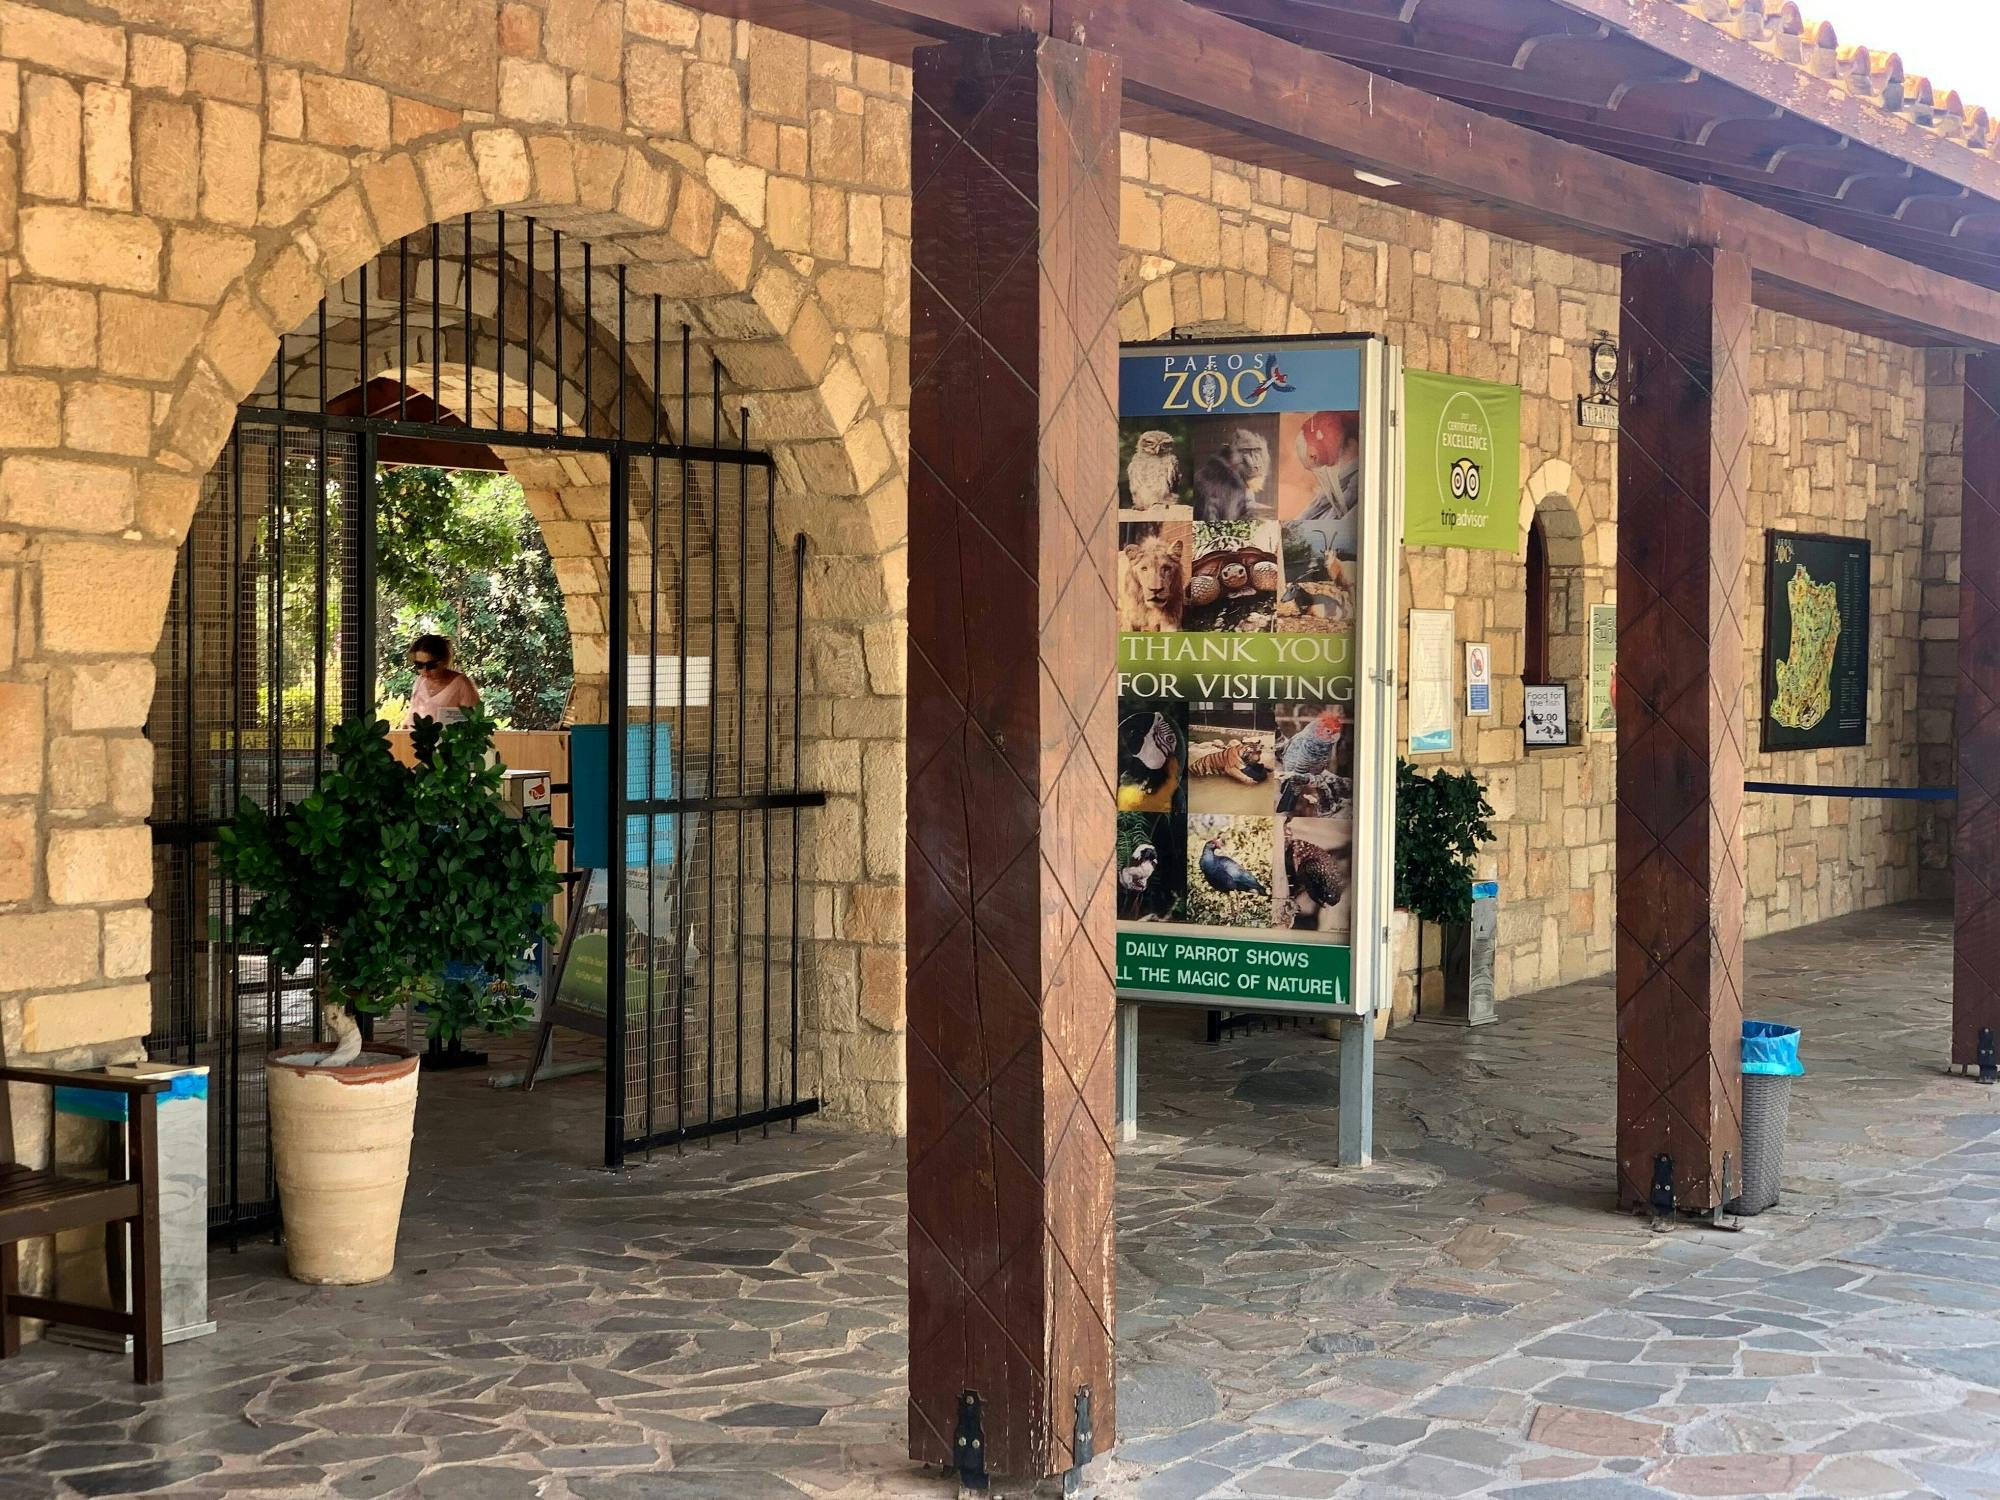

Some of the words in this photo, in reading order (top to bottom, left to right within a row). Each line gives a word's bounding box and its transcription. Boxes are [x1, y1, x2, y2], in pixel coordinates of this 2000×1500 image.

[1165, 353, 1264, 372] PAFOS
[1162, 369, 1268, 411] ZOO
[1442, 433, 1488, 450] EXCELLENCE
[1441, 508, 1488, 530] tripadvisor
[1122, 636, 1258, 663] THANK
[1268, 637, 1349, 664] YOU
[1117, 672, 1185, 698] FOR
[1193, 673, 1354, 701] VISITING
[1527, 692, 1548, 700] Food
[1550, 691, 1562, 700] for
[1126, 941, 1168, 958] DAILY
[1175, 944, 1239, 963] PARROT
[1246, 949, 1309, 968] SHOWS
[1115, 965, 1133, 980] LL
[1139, 966, 1170, 983] THE
[1177, 969, 1230, 988] MAGIC
[1237, 973, 1260, 990] OF
[1267, 976, 1333, 995] NATURE
